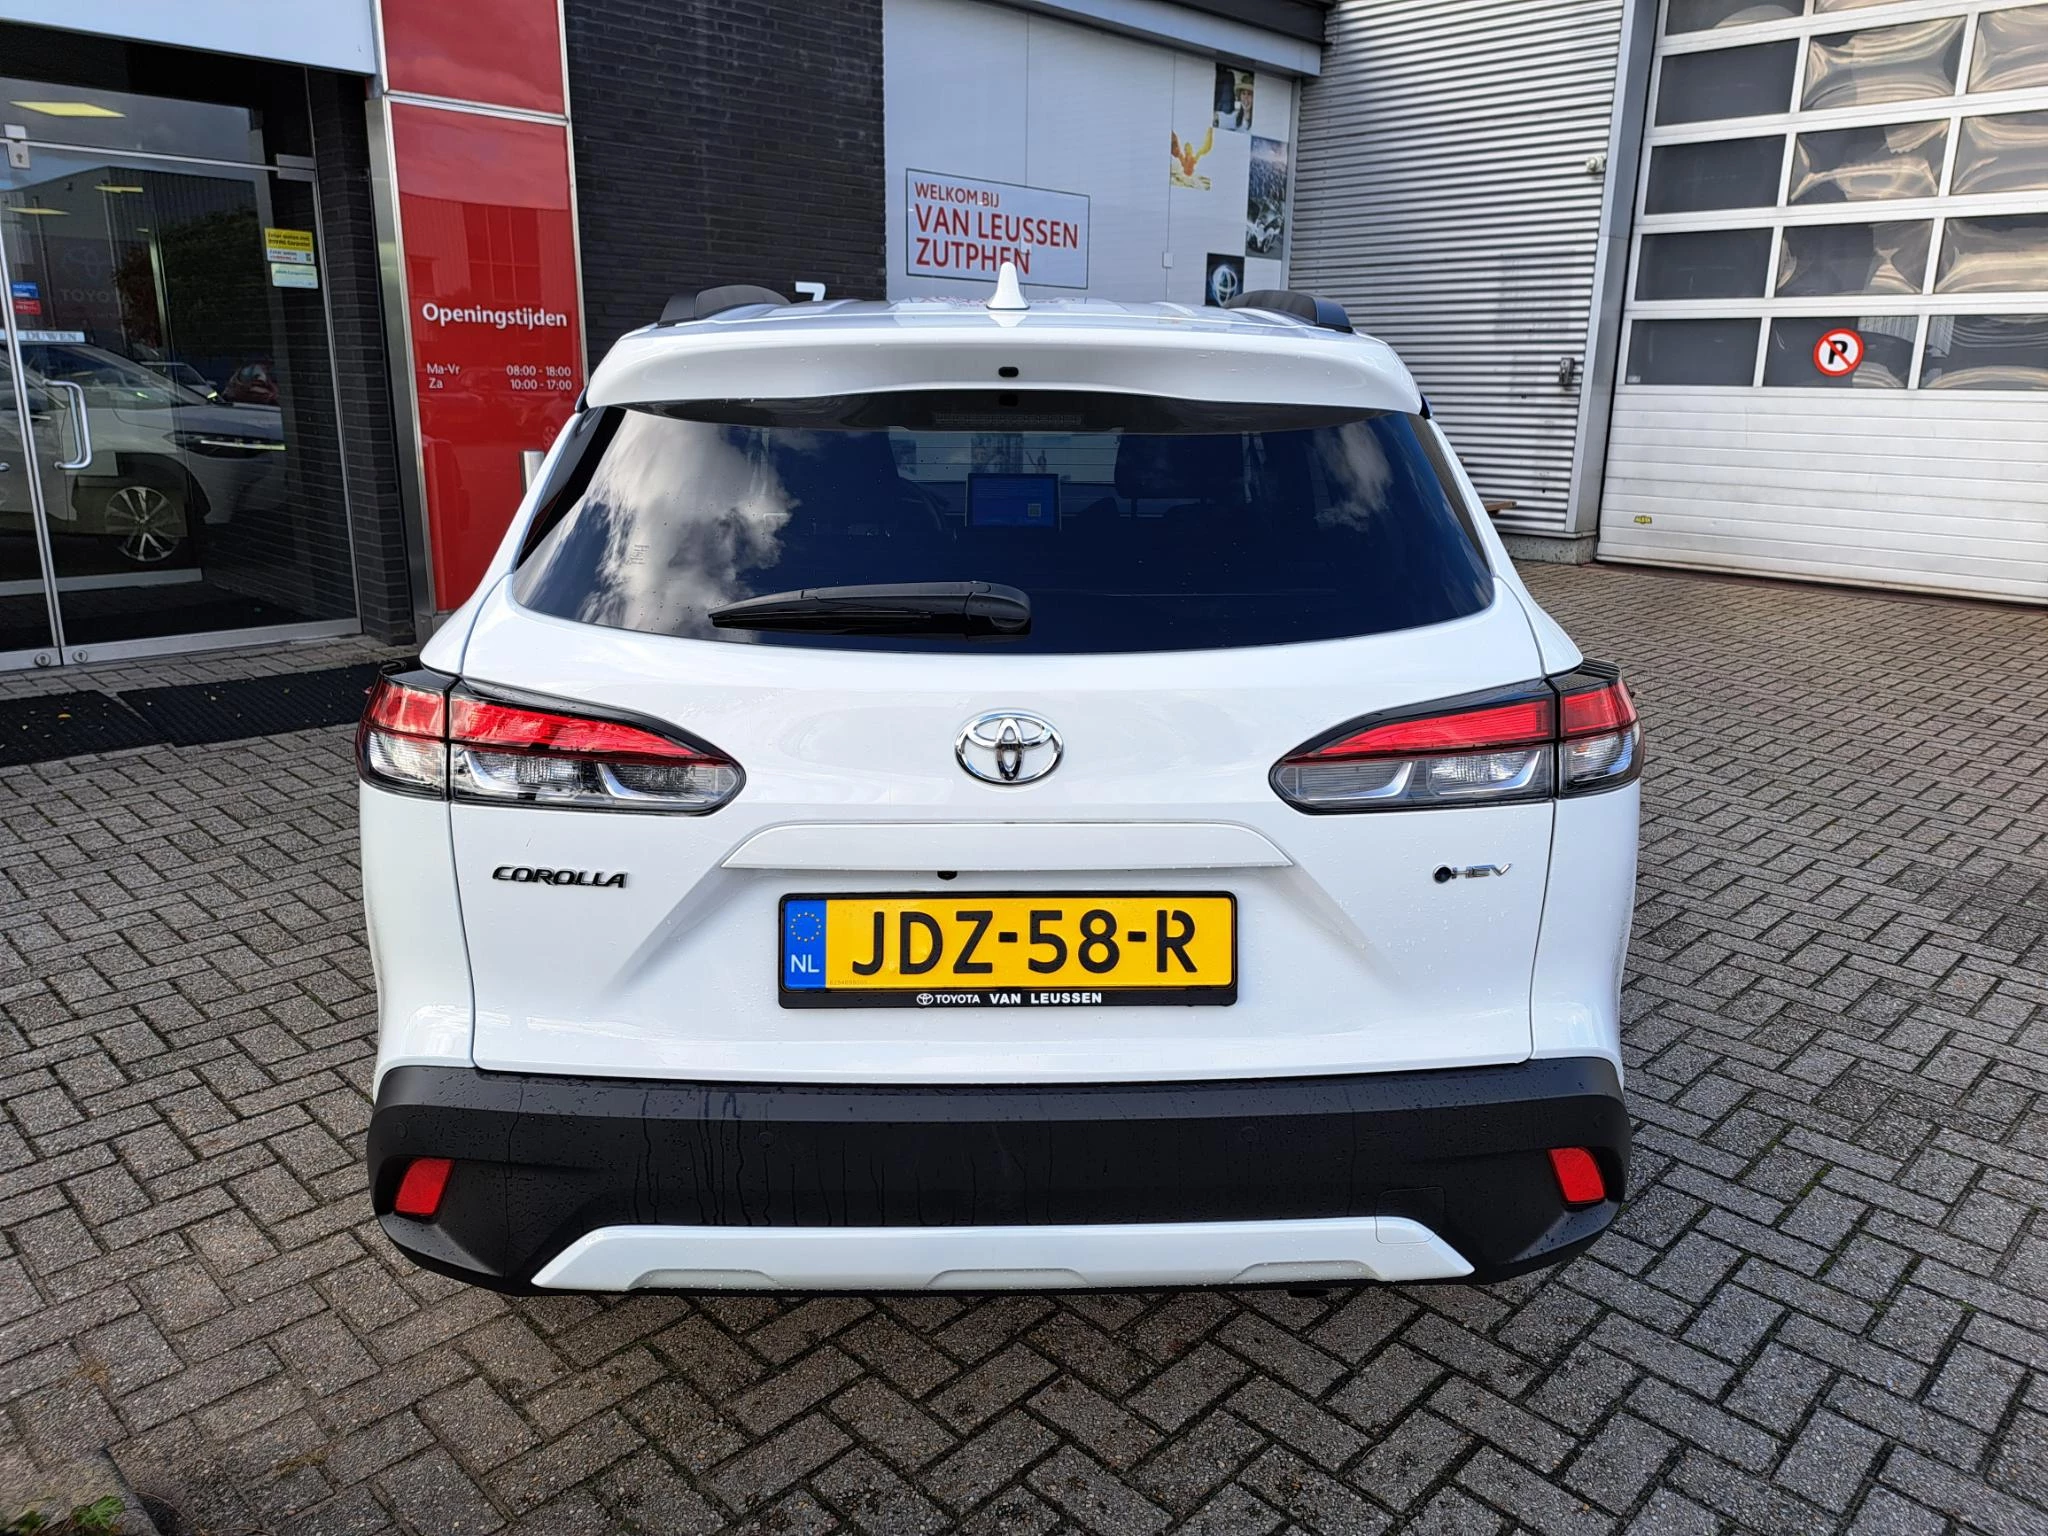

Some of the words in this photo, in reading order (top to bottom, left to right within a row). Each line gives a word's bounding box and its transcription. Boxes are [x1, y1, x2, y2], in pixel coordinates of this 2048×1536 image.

[914, 182, 978, 205] WELKOM
[981, 191, 1000, 208] BIJ
[915, 203, 969, 237] VAN
[977, 211, 1079, 249] LEUSSEN
[915, 237, 1031, 275] ZUTPHEN
[60, 287, 134, 309] TOYOA
[422, 302, 568, 329] Openingstijden
[426, 362, 460, 375] Ma-Vr
[506, 365, 536, 376] 08:00
[545, 366, 571, 377] 18:00
[428, 377, 444, 389] Za
[510, 379, 538, 390] 10:00
[547, 380, 572, 390] 17:00
[492, 866, 629, 889] COROLLA
[852, 909, 1198, 976] JDZ-58-R
[790, 955, 820, 973] NL
[935, 994, 981, 1004] TOYOTA
[989, 993, 1021, 1004] VAN
[1030, 992, 1102, 1004] LEUSSEN
